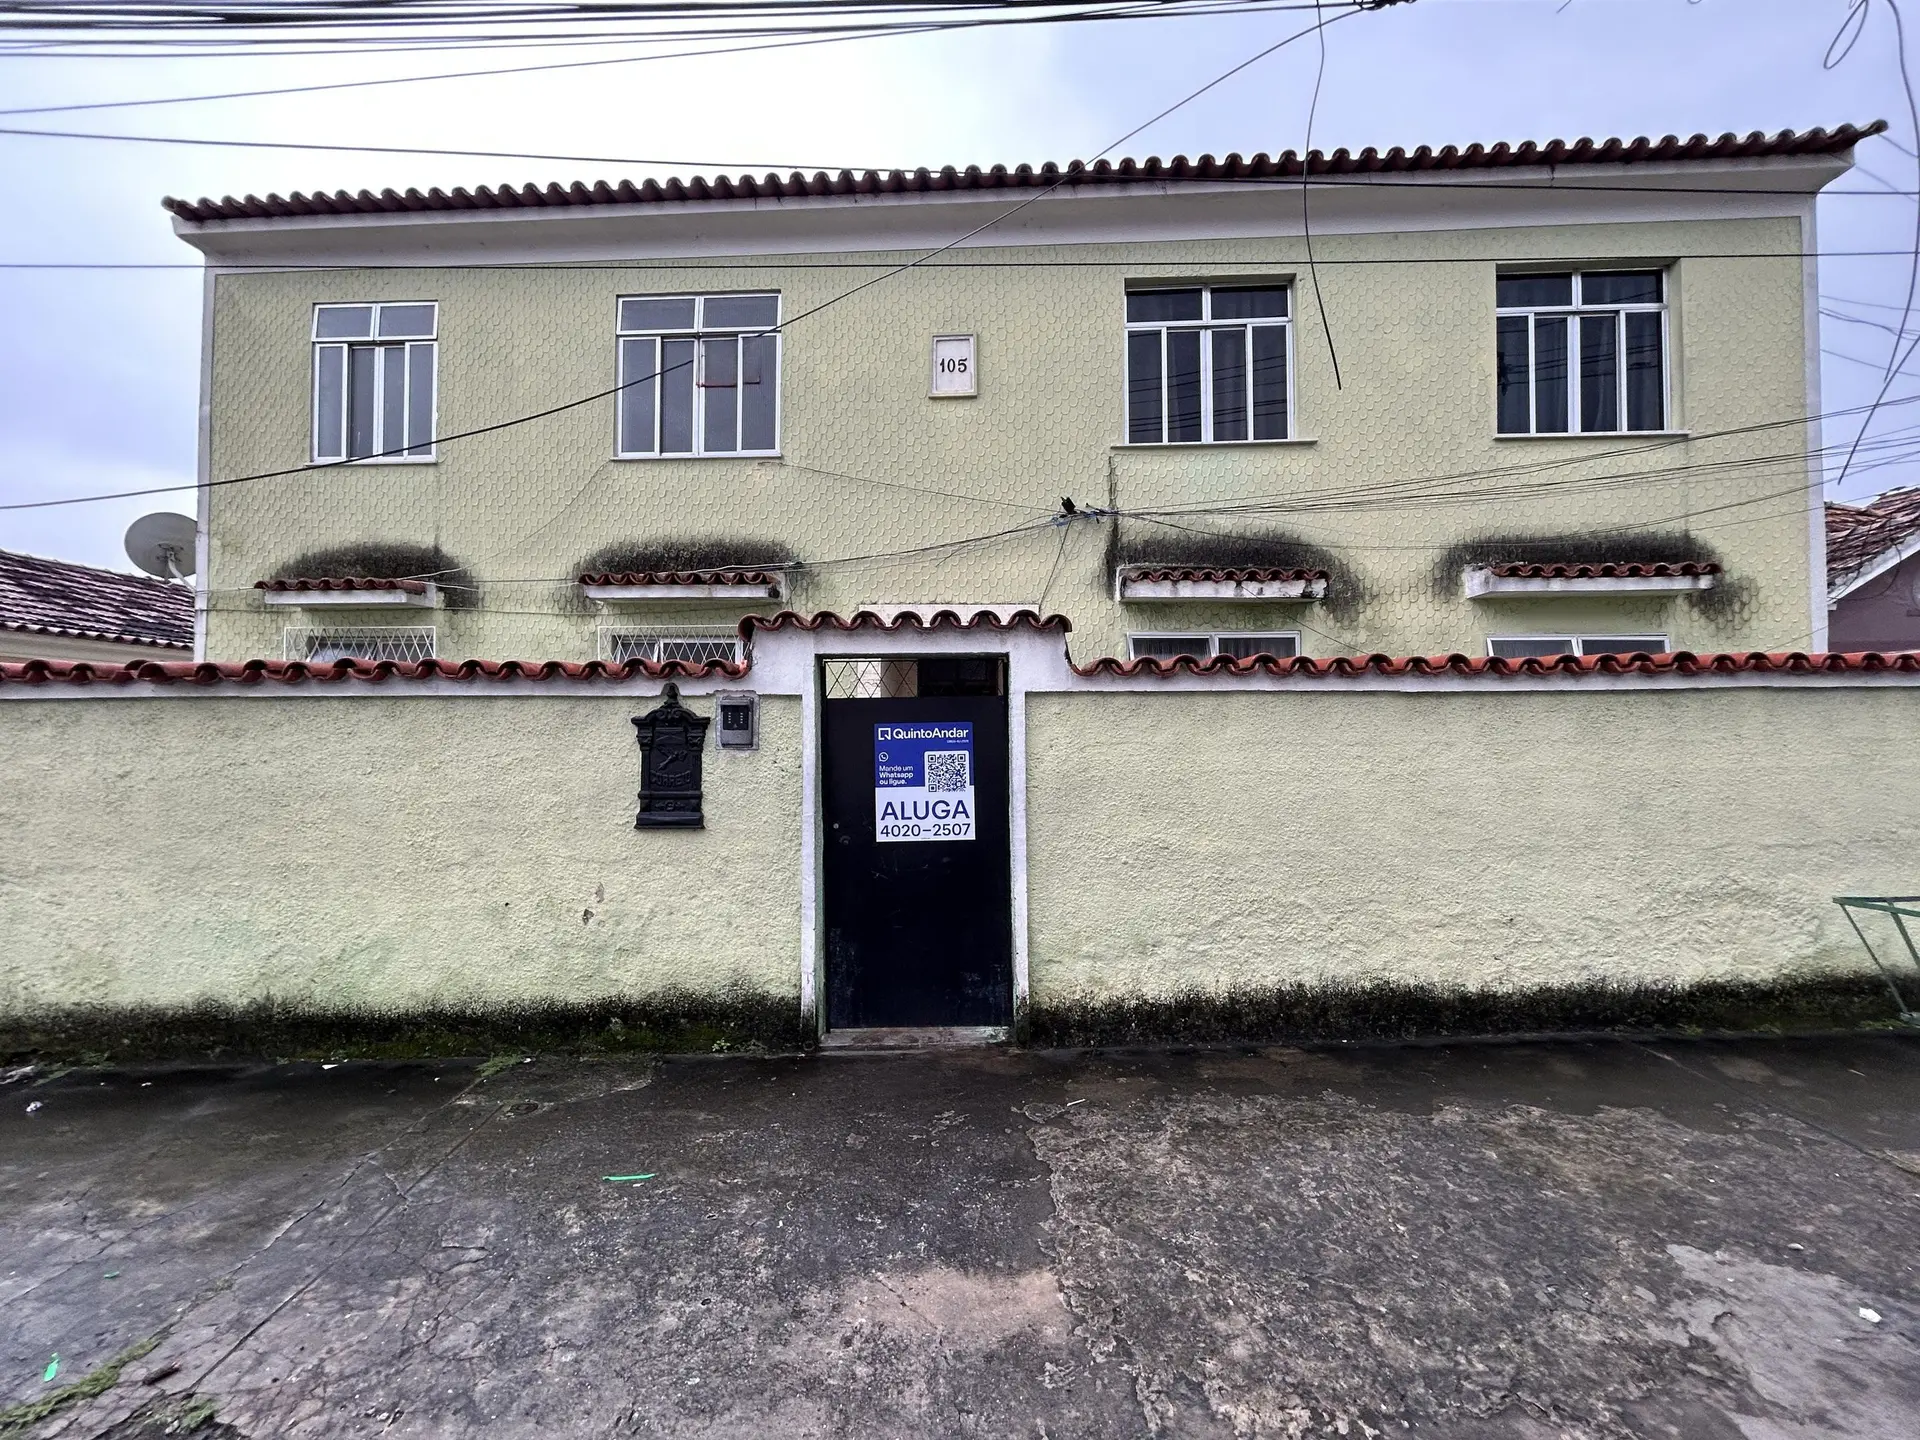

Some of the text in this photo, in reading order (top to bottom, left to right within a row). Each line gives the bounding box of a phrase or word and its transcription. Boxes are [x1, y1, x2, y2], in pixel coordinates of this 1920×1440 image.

[940, 358, 968, 373] 105
[893, 727, 969, 740] QuintoAndar
[880, 800, 970, 821] ALUGA
[880, 823, 971, 837] 4020-2507
